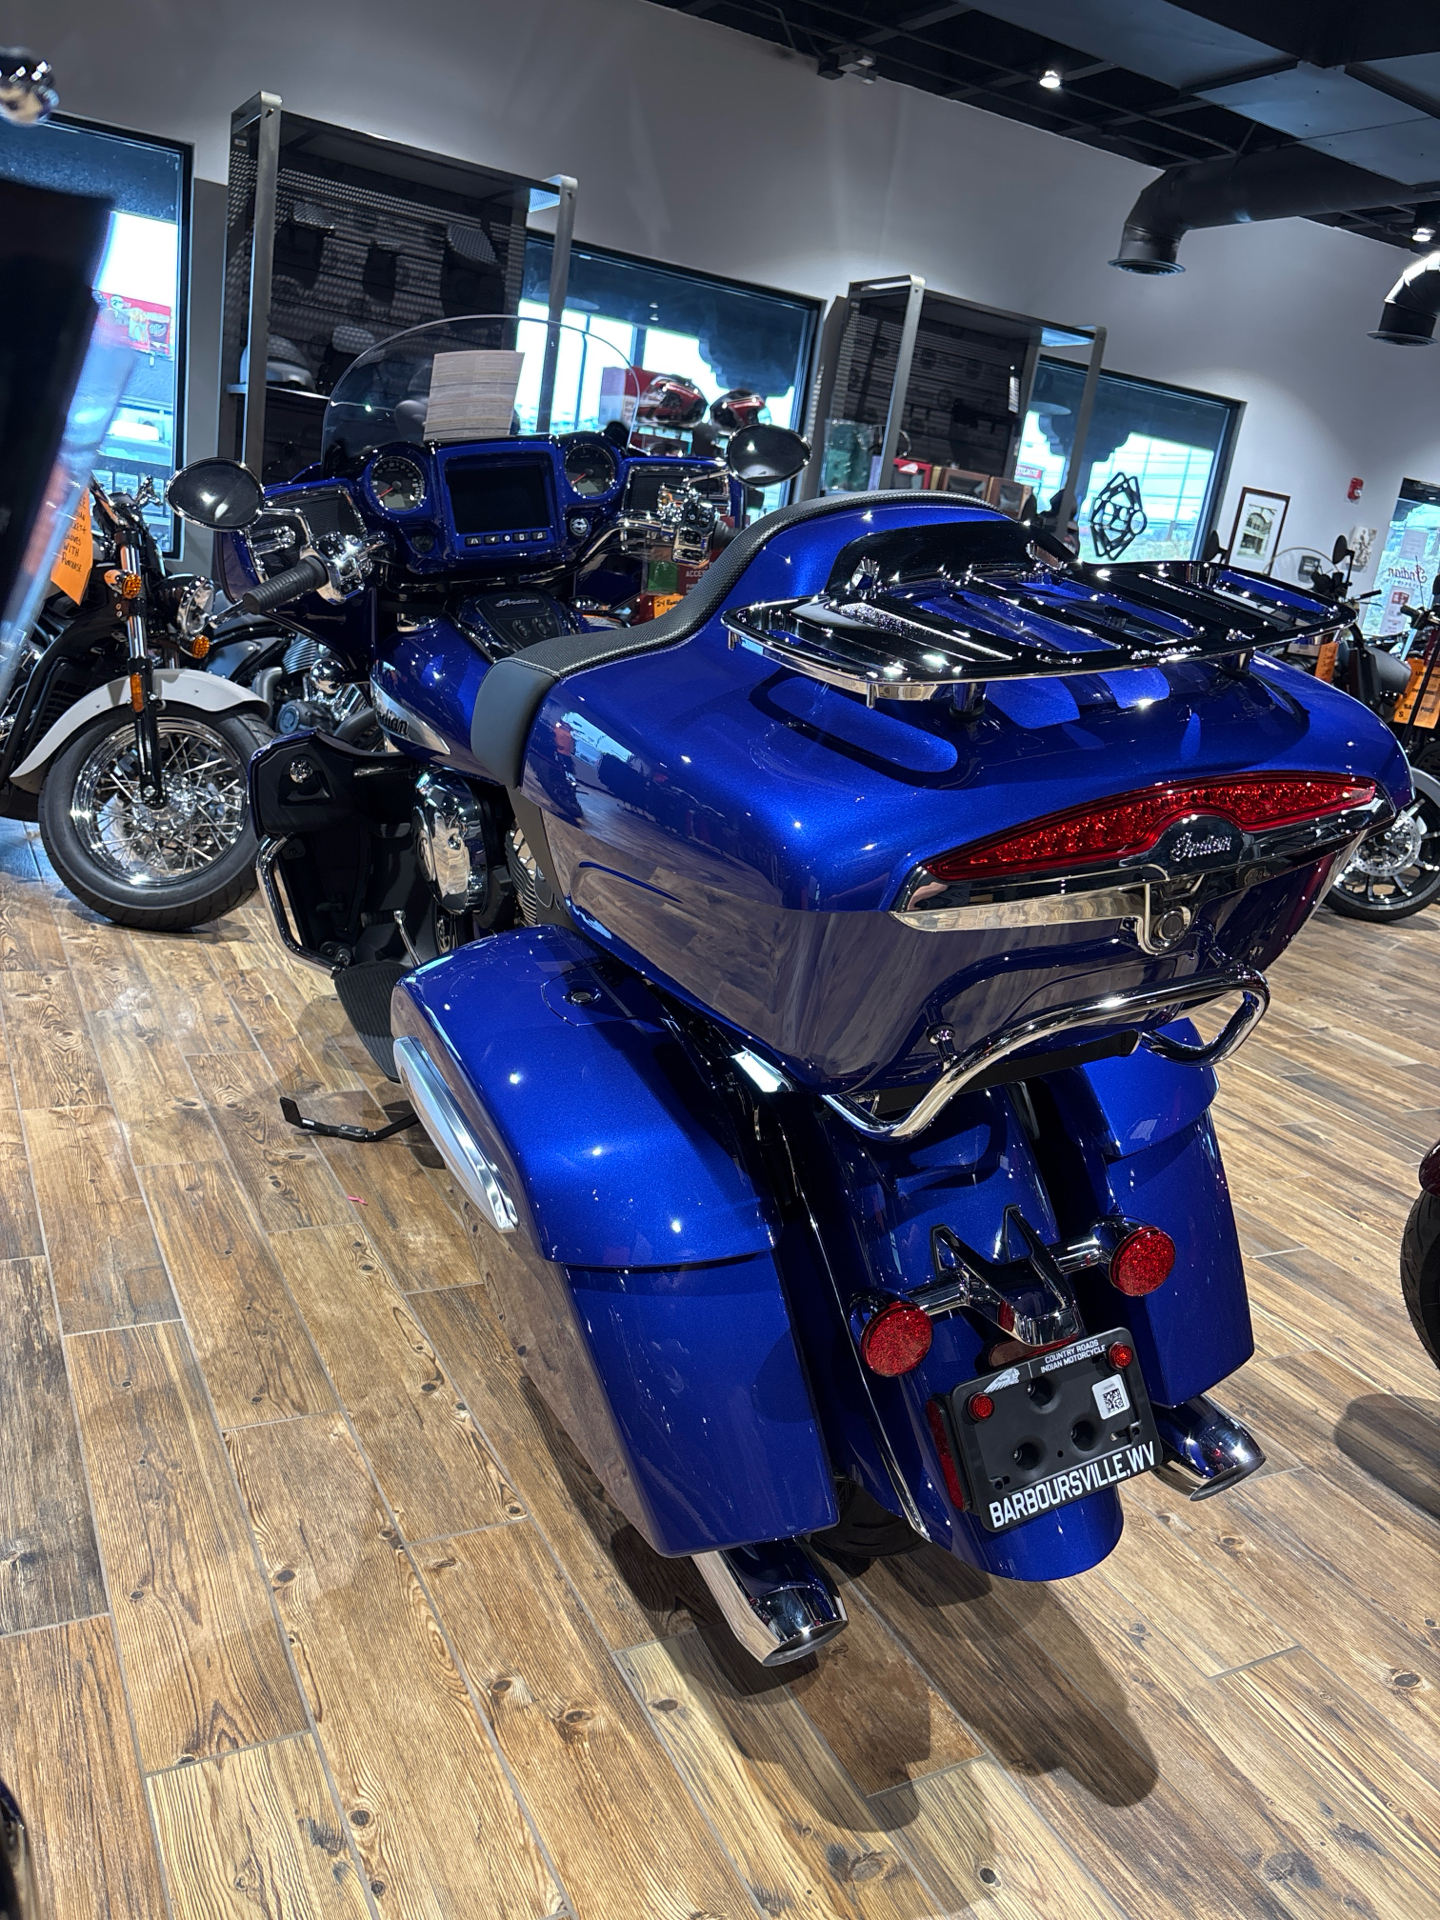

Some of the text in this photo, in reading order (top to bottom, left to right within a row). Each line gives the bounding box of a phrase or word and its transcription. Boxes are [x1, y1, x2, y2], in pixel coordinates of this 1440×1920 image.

[1169, 831, 1233, 862] Indian
[1040, 1344, 1107, 1374] INDIAN MOTORCYCLE
[1044, 1339, 1099, 1364] COUNTRY ROADS
